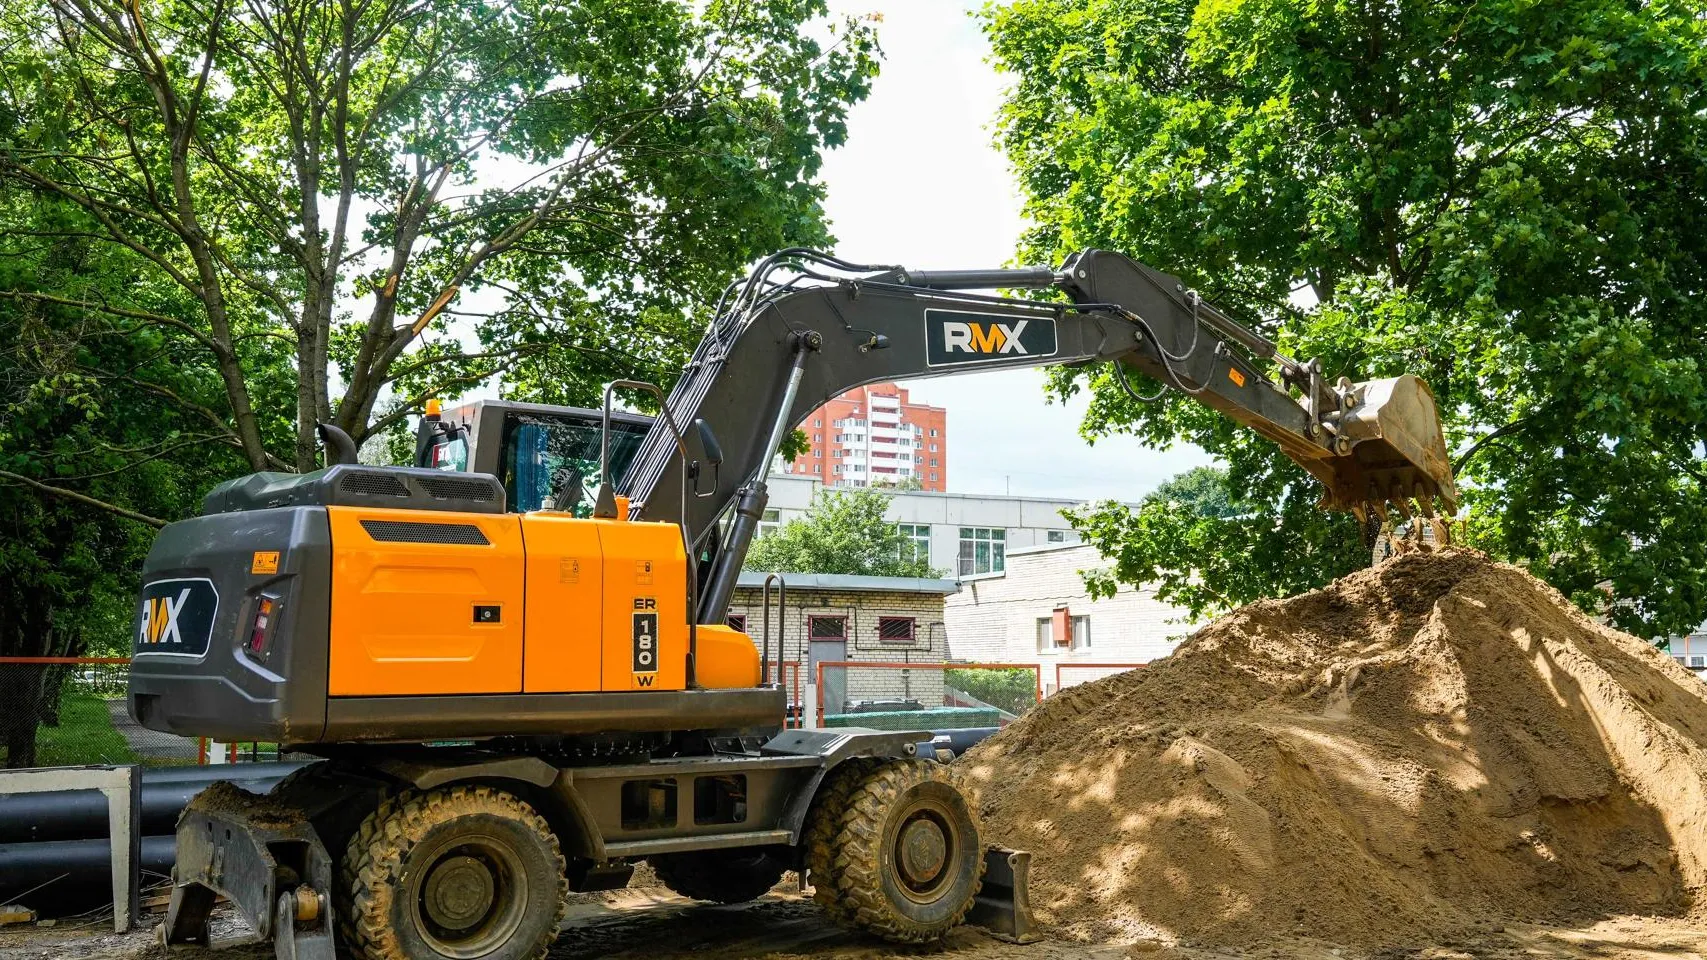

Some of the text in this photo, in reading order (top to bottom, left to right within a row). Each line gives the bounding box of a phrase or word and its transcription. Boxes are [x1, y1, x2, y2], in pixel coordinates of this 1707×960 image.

[943, 320, 1029, 354] RMX
[139, 588, 191, 644] RMX
[633, 598, 656, 610] ER
[638, 620, 652, 665] 180
[637, 676, 654, 687] W
